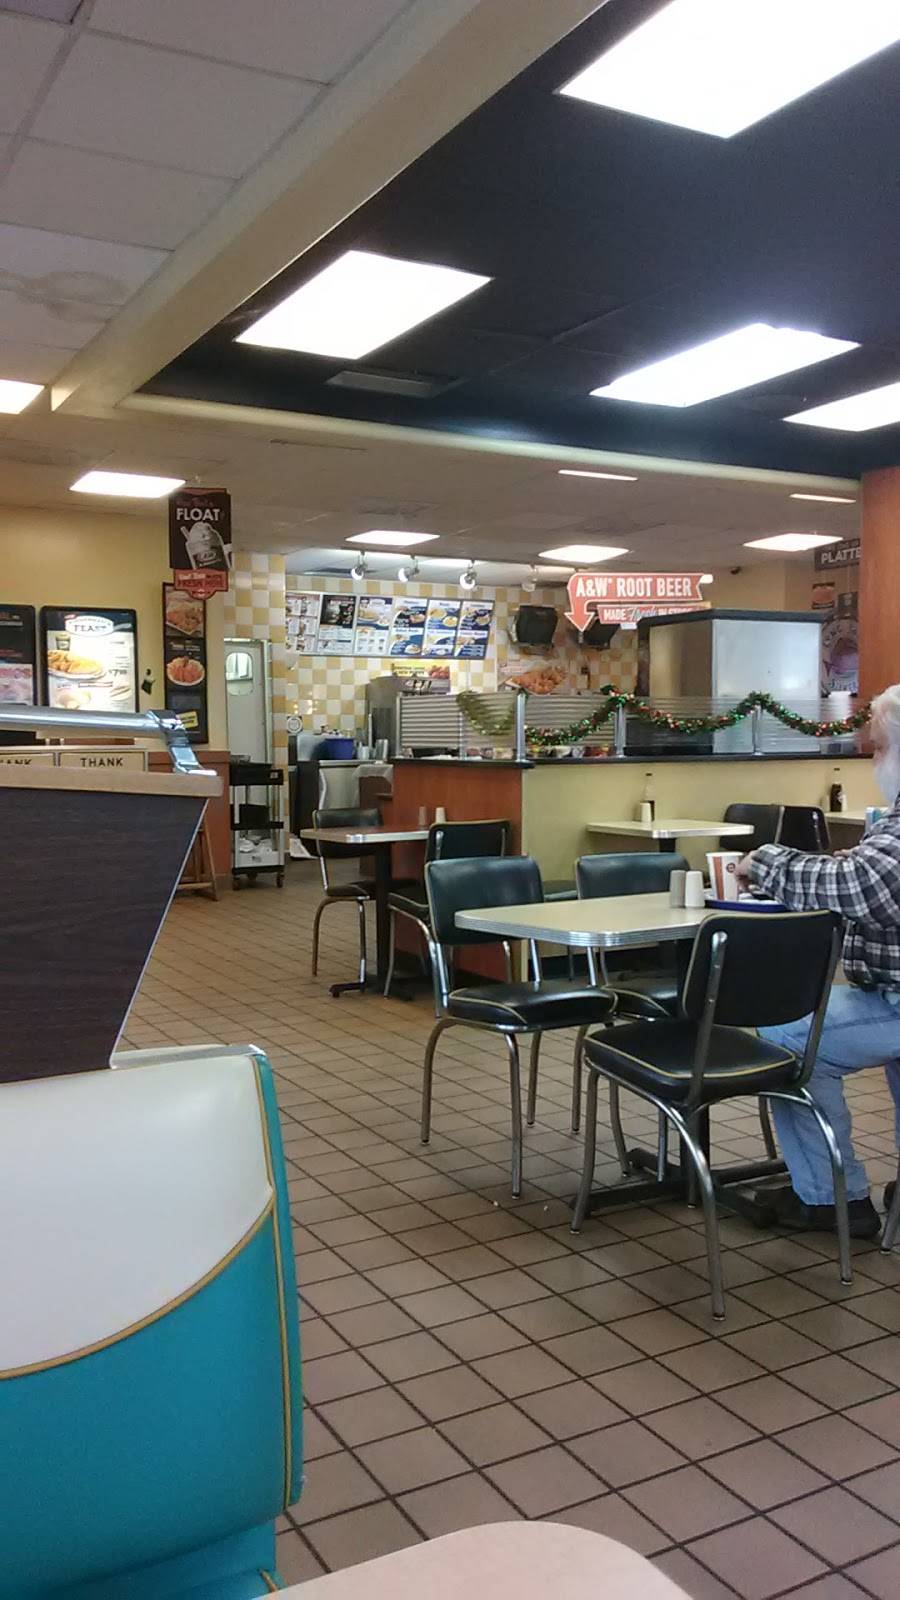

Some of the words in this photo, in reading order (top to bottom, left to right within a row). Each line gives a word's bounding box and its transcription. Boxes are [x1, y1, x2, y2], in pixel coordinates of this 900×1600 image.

[176, 507, 220, 521] FLOAT
[616, 577, 653, 597] ROOT
[656, 577, 692, 597] BEER
[603, 608, 627, 621] MADE
[80, 757, 124, 767] THANK
